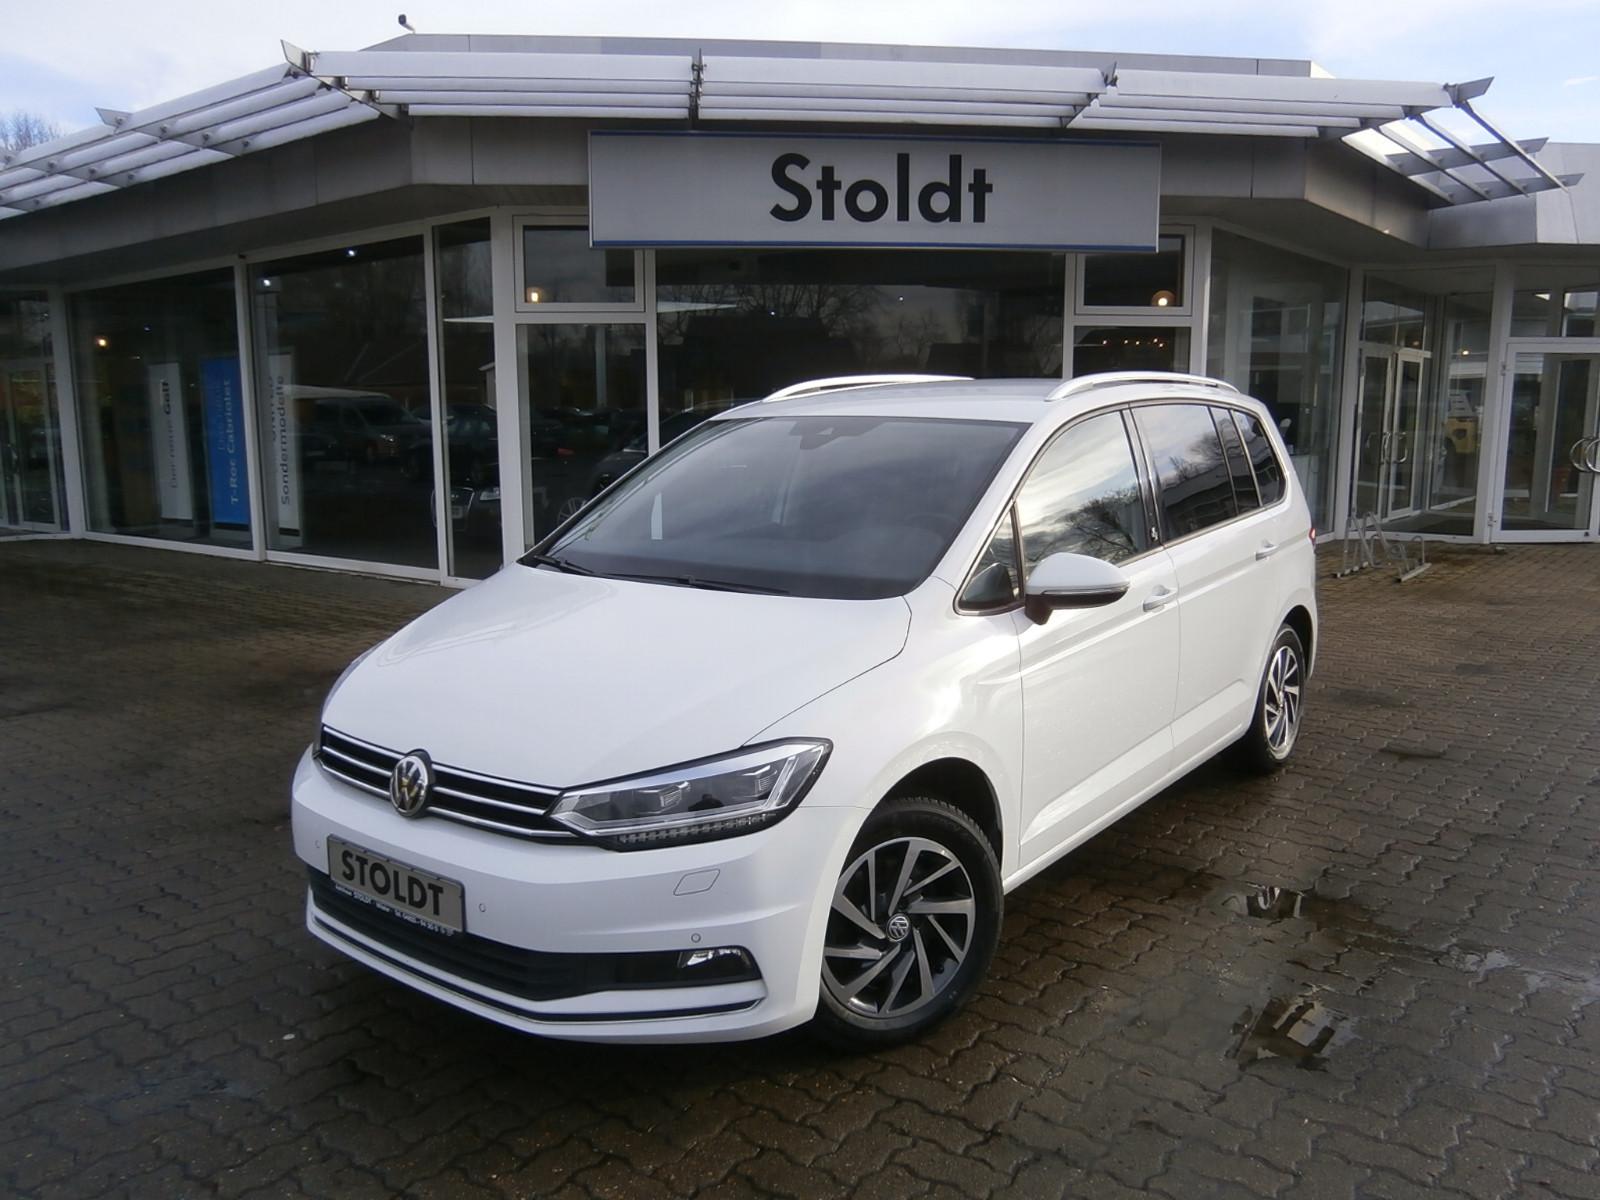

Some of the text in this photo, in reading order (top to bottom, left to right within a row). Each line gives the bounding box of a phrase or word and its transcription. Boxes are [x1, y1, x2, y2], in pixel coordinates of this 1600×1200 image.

[769, 152, 994, 223] Stoldt
[223, 378, 239, 505] T-Roc Cabriolet
[275, 375, 290, 505] Sondermodelle
[341, 849, 444, 917] STOLDT
